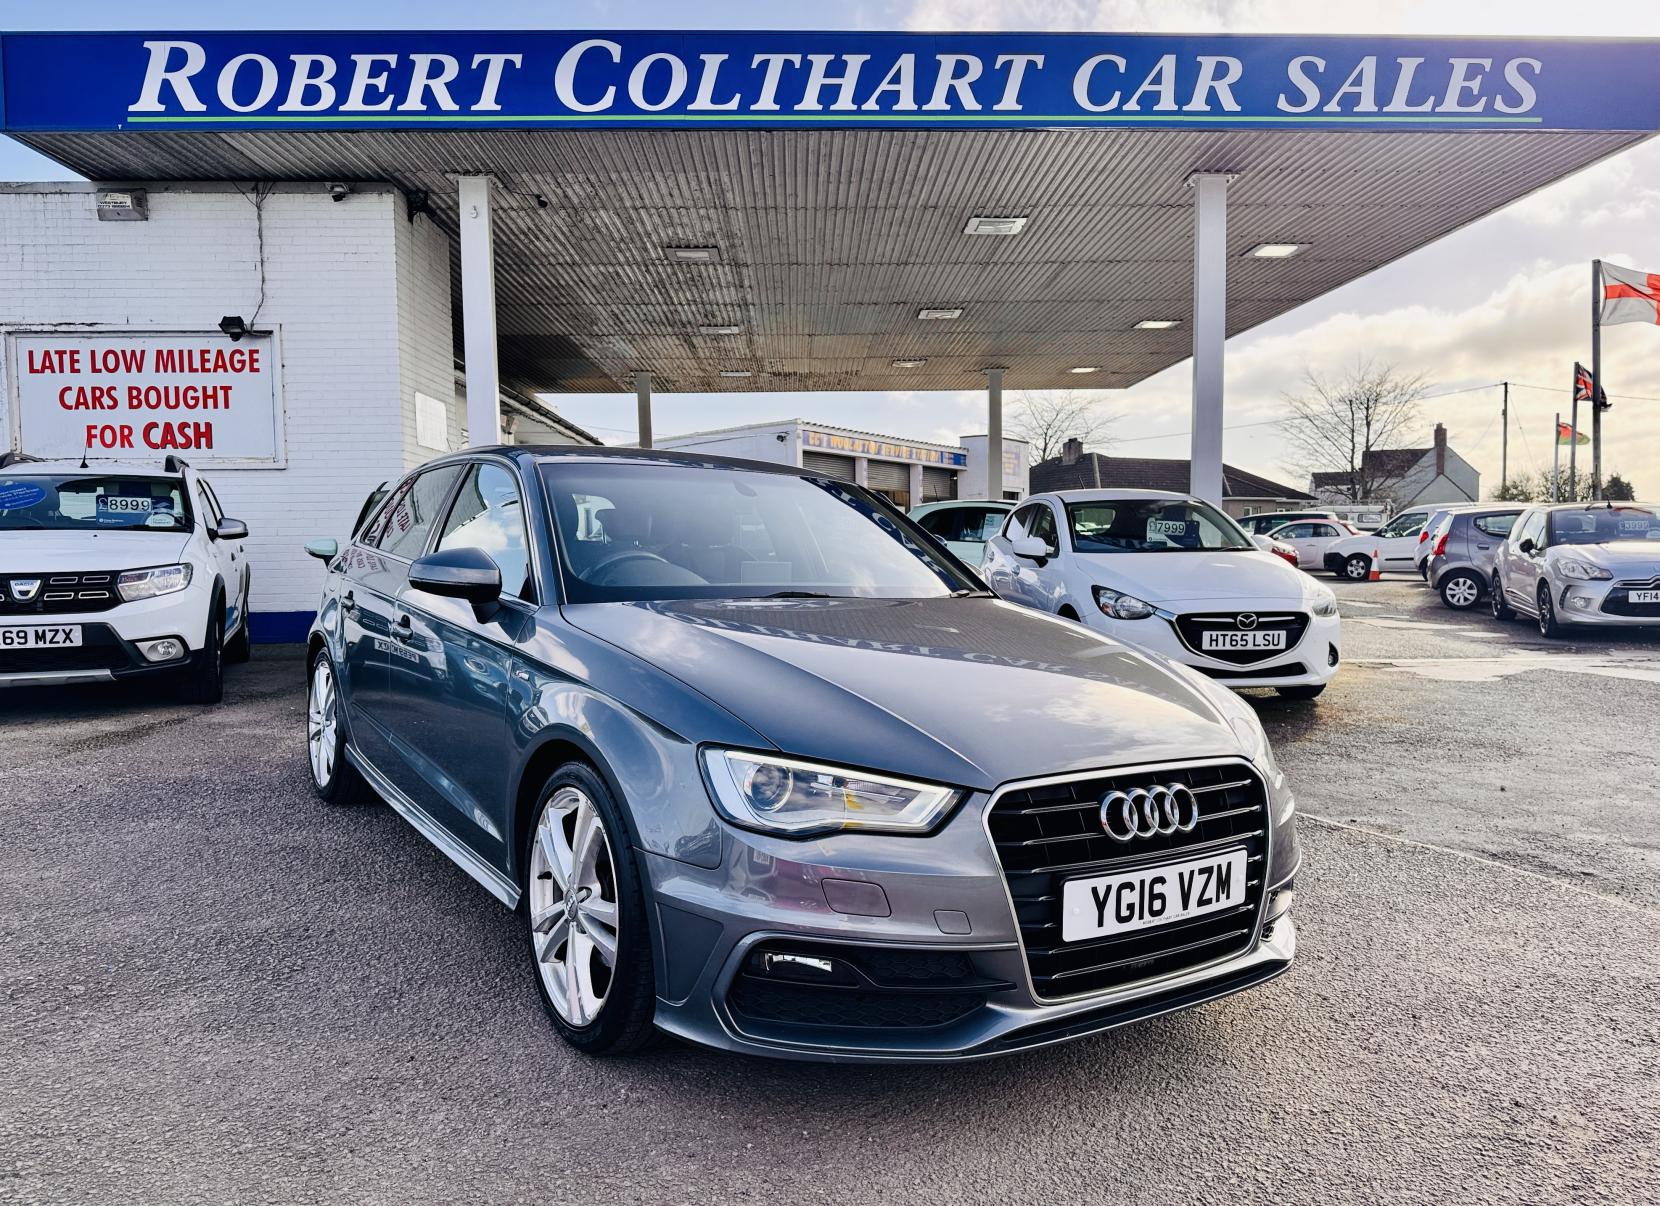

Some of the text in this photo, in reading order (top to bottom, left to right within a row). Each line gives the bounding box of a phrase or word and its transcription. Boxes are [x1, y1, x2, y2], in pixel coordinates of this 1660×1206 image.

[128, 39, 1543, 115] ROBERT COLTHART CAR SALES
[28, 349, 260, 374] LATE LOW MILEAGE
[58, 385, 233, 410] CARS BOUGHT
[86, 421, 213, 450] FOR CASH
[1636, 592, 1659, 601] YF14
[0, 628, 74, 646] 69 MZX
[1209, 632, 1281, 648] HT65 LSU
[1091, 860, 1232, 929] YG16 VZM
